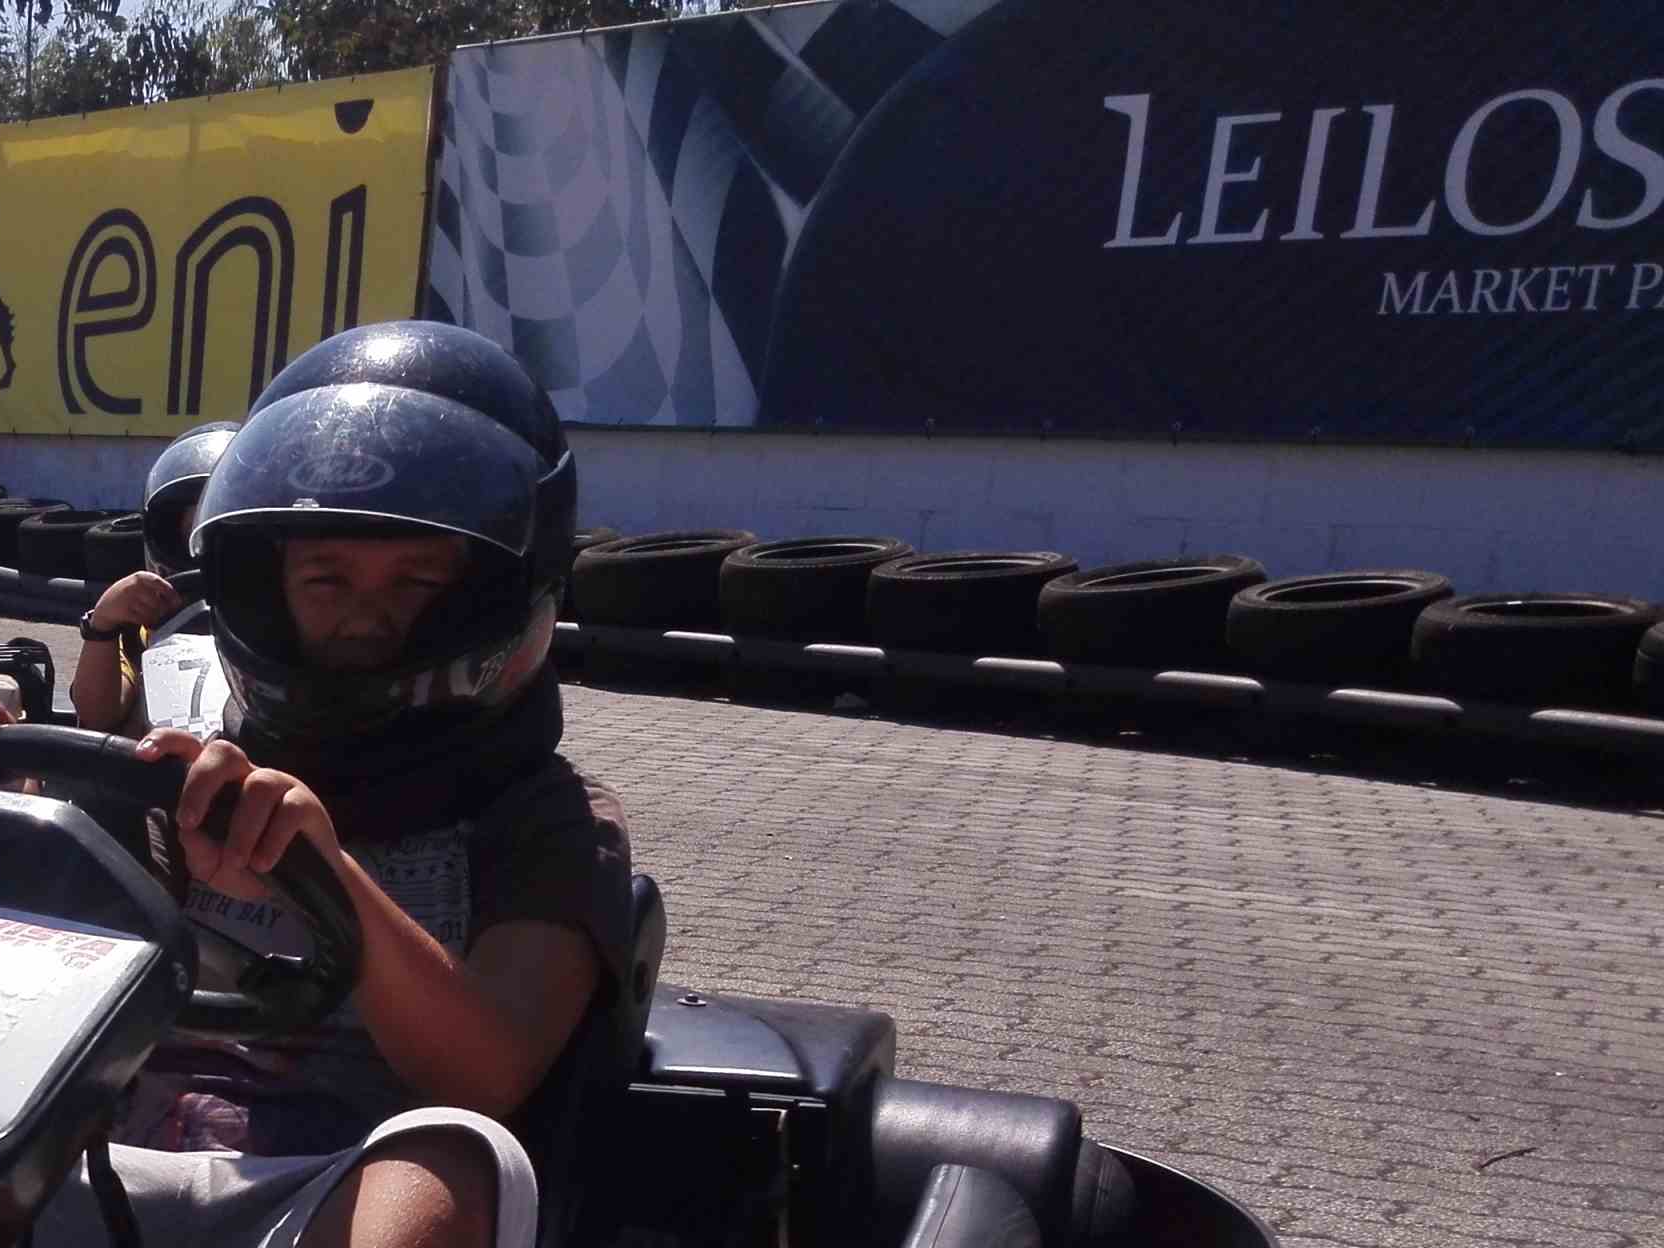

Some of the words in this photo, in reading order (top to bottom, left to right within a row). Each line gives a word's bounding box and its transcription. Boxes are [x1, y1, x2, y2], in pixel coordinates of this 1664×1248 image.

[58, 99, 374, 415] eni
[1377, 264, 1614, 315] MARKET
[1625, 262, 1664, 310] P
